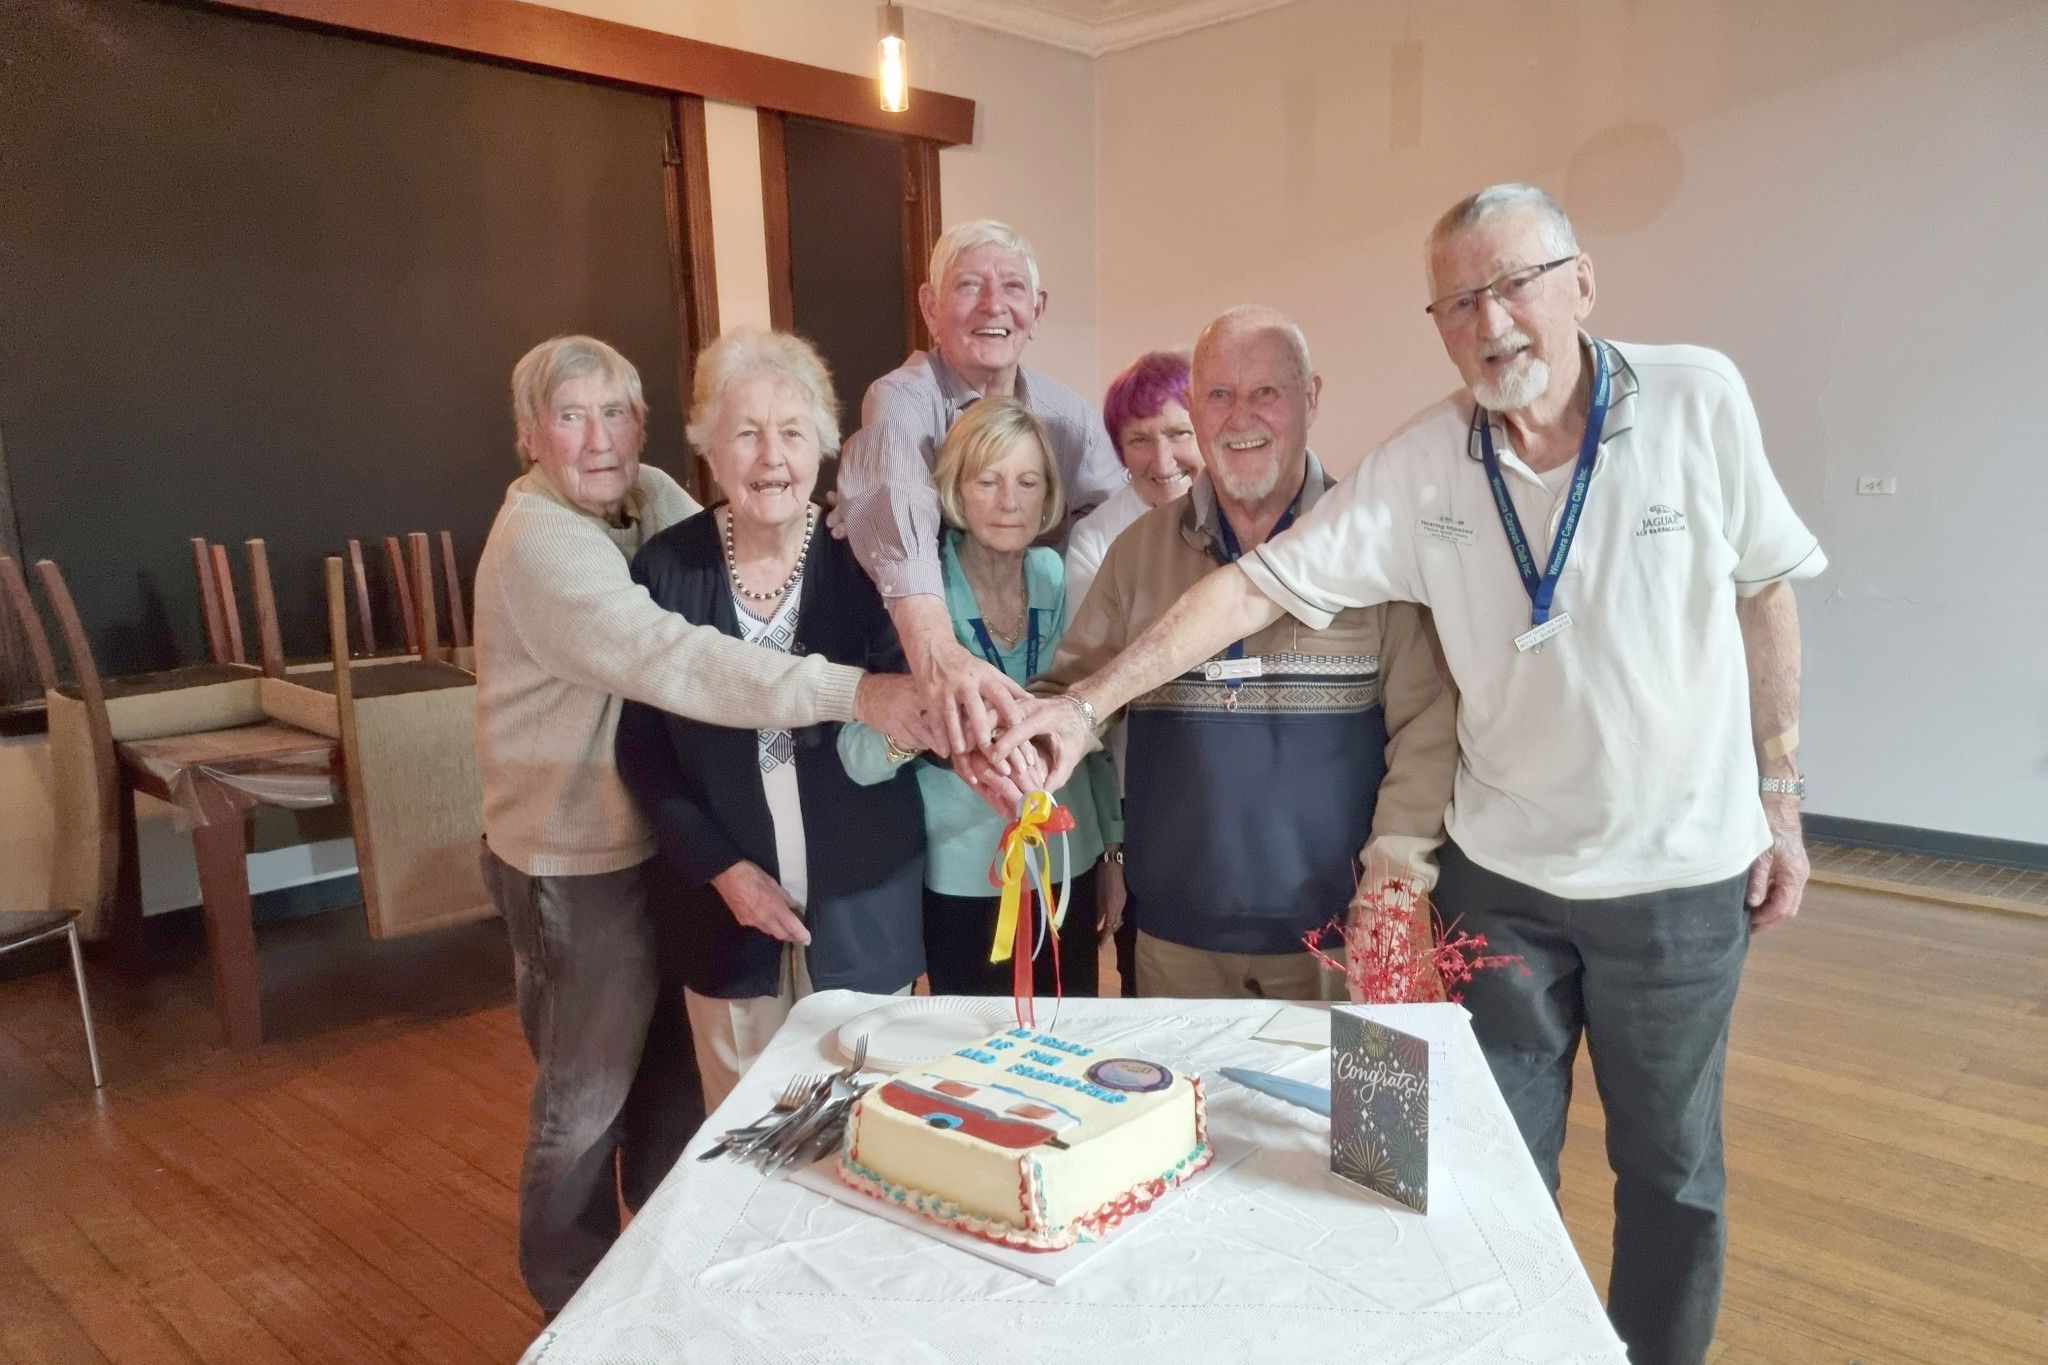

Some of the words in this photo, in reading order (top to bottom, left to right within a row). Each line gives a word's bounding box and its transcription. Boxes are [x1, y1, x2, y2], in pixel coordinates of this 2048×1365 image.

[1421, 519, 1445, 530] Hearing
[1548, 538, 1568, 576] Wimmera
[1562, 503, 1579, 537] Caravan
[1572, 481, 1585, 502] Club
[1516, 544, 1529, 563] Club
[1337, 1052, 1425, 1103] Congrats!
